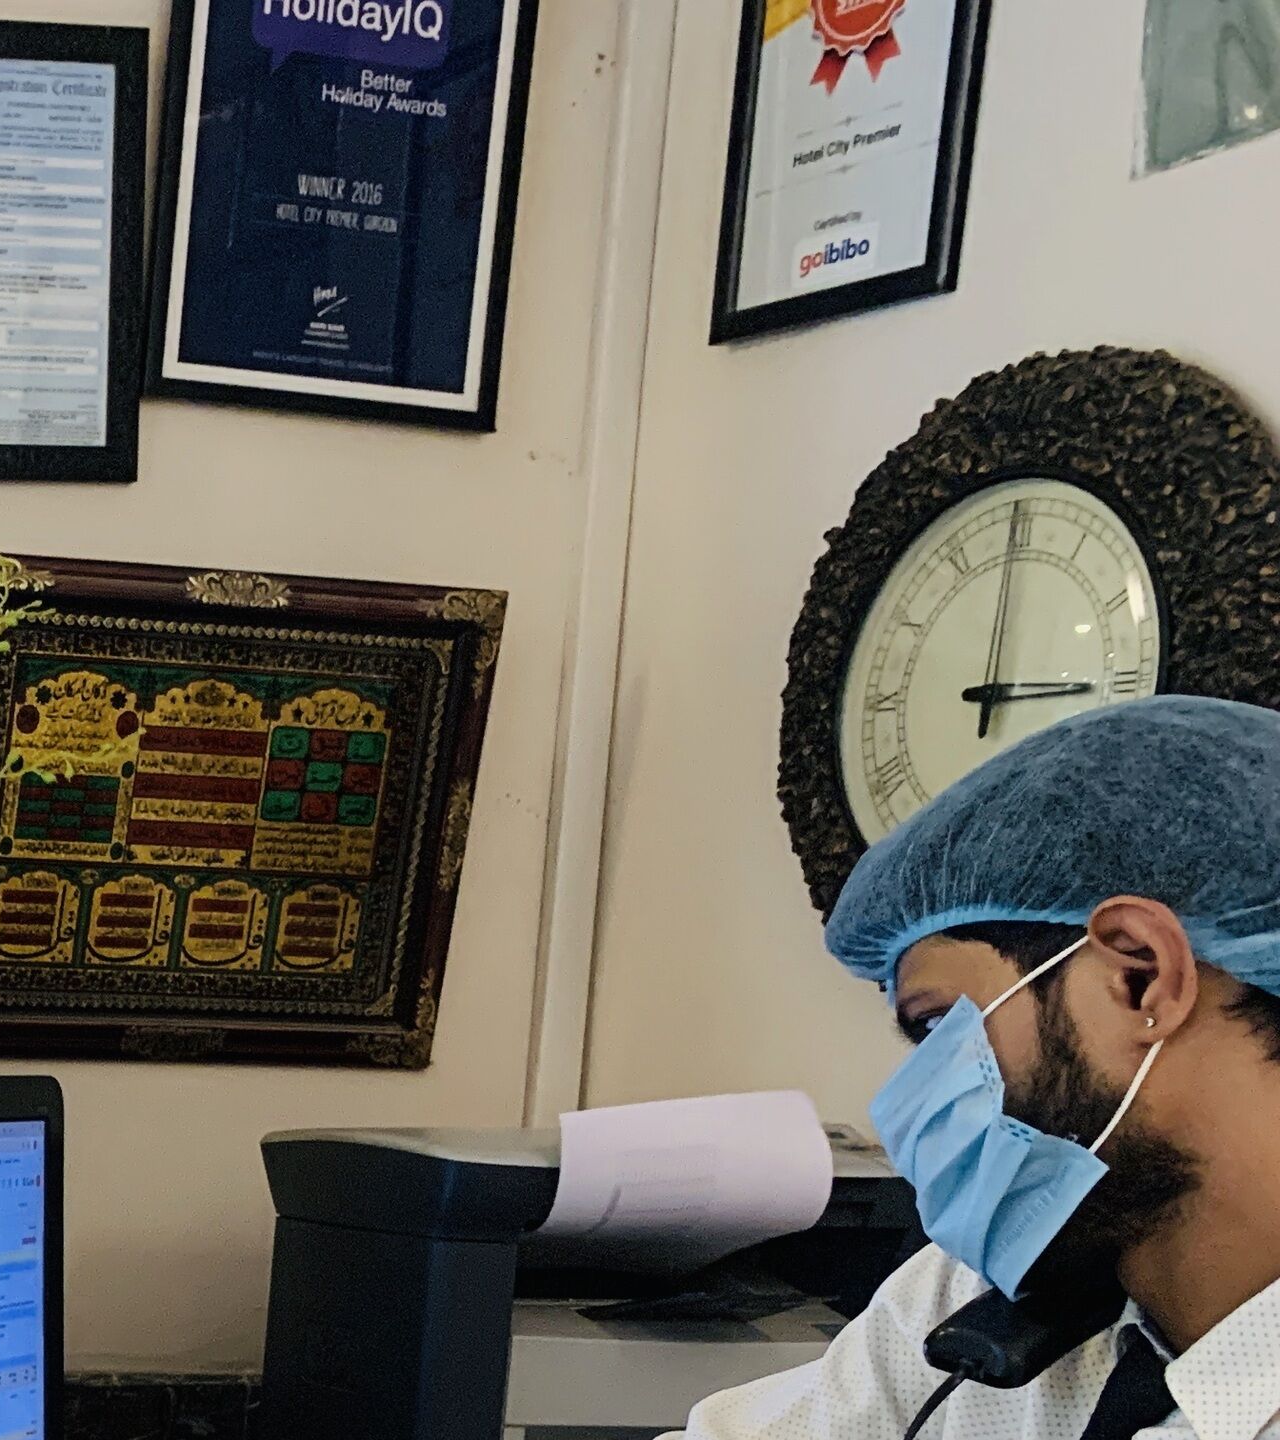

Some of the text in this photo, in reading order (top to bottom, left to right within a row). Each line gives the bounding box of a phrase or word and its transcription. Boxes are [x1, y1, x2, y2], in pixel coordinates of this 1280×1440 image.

[361, 69, 413, 93] Better
[322, 83, 447, 117] Holiday Awards
[792, 123, 901, 168] Hotel City Premier
[298, 174, 383, 205] WINNER 2016
[799, 237, 870, 278] goibibo
